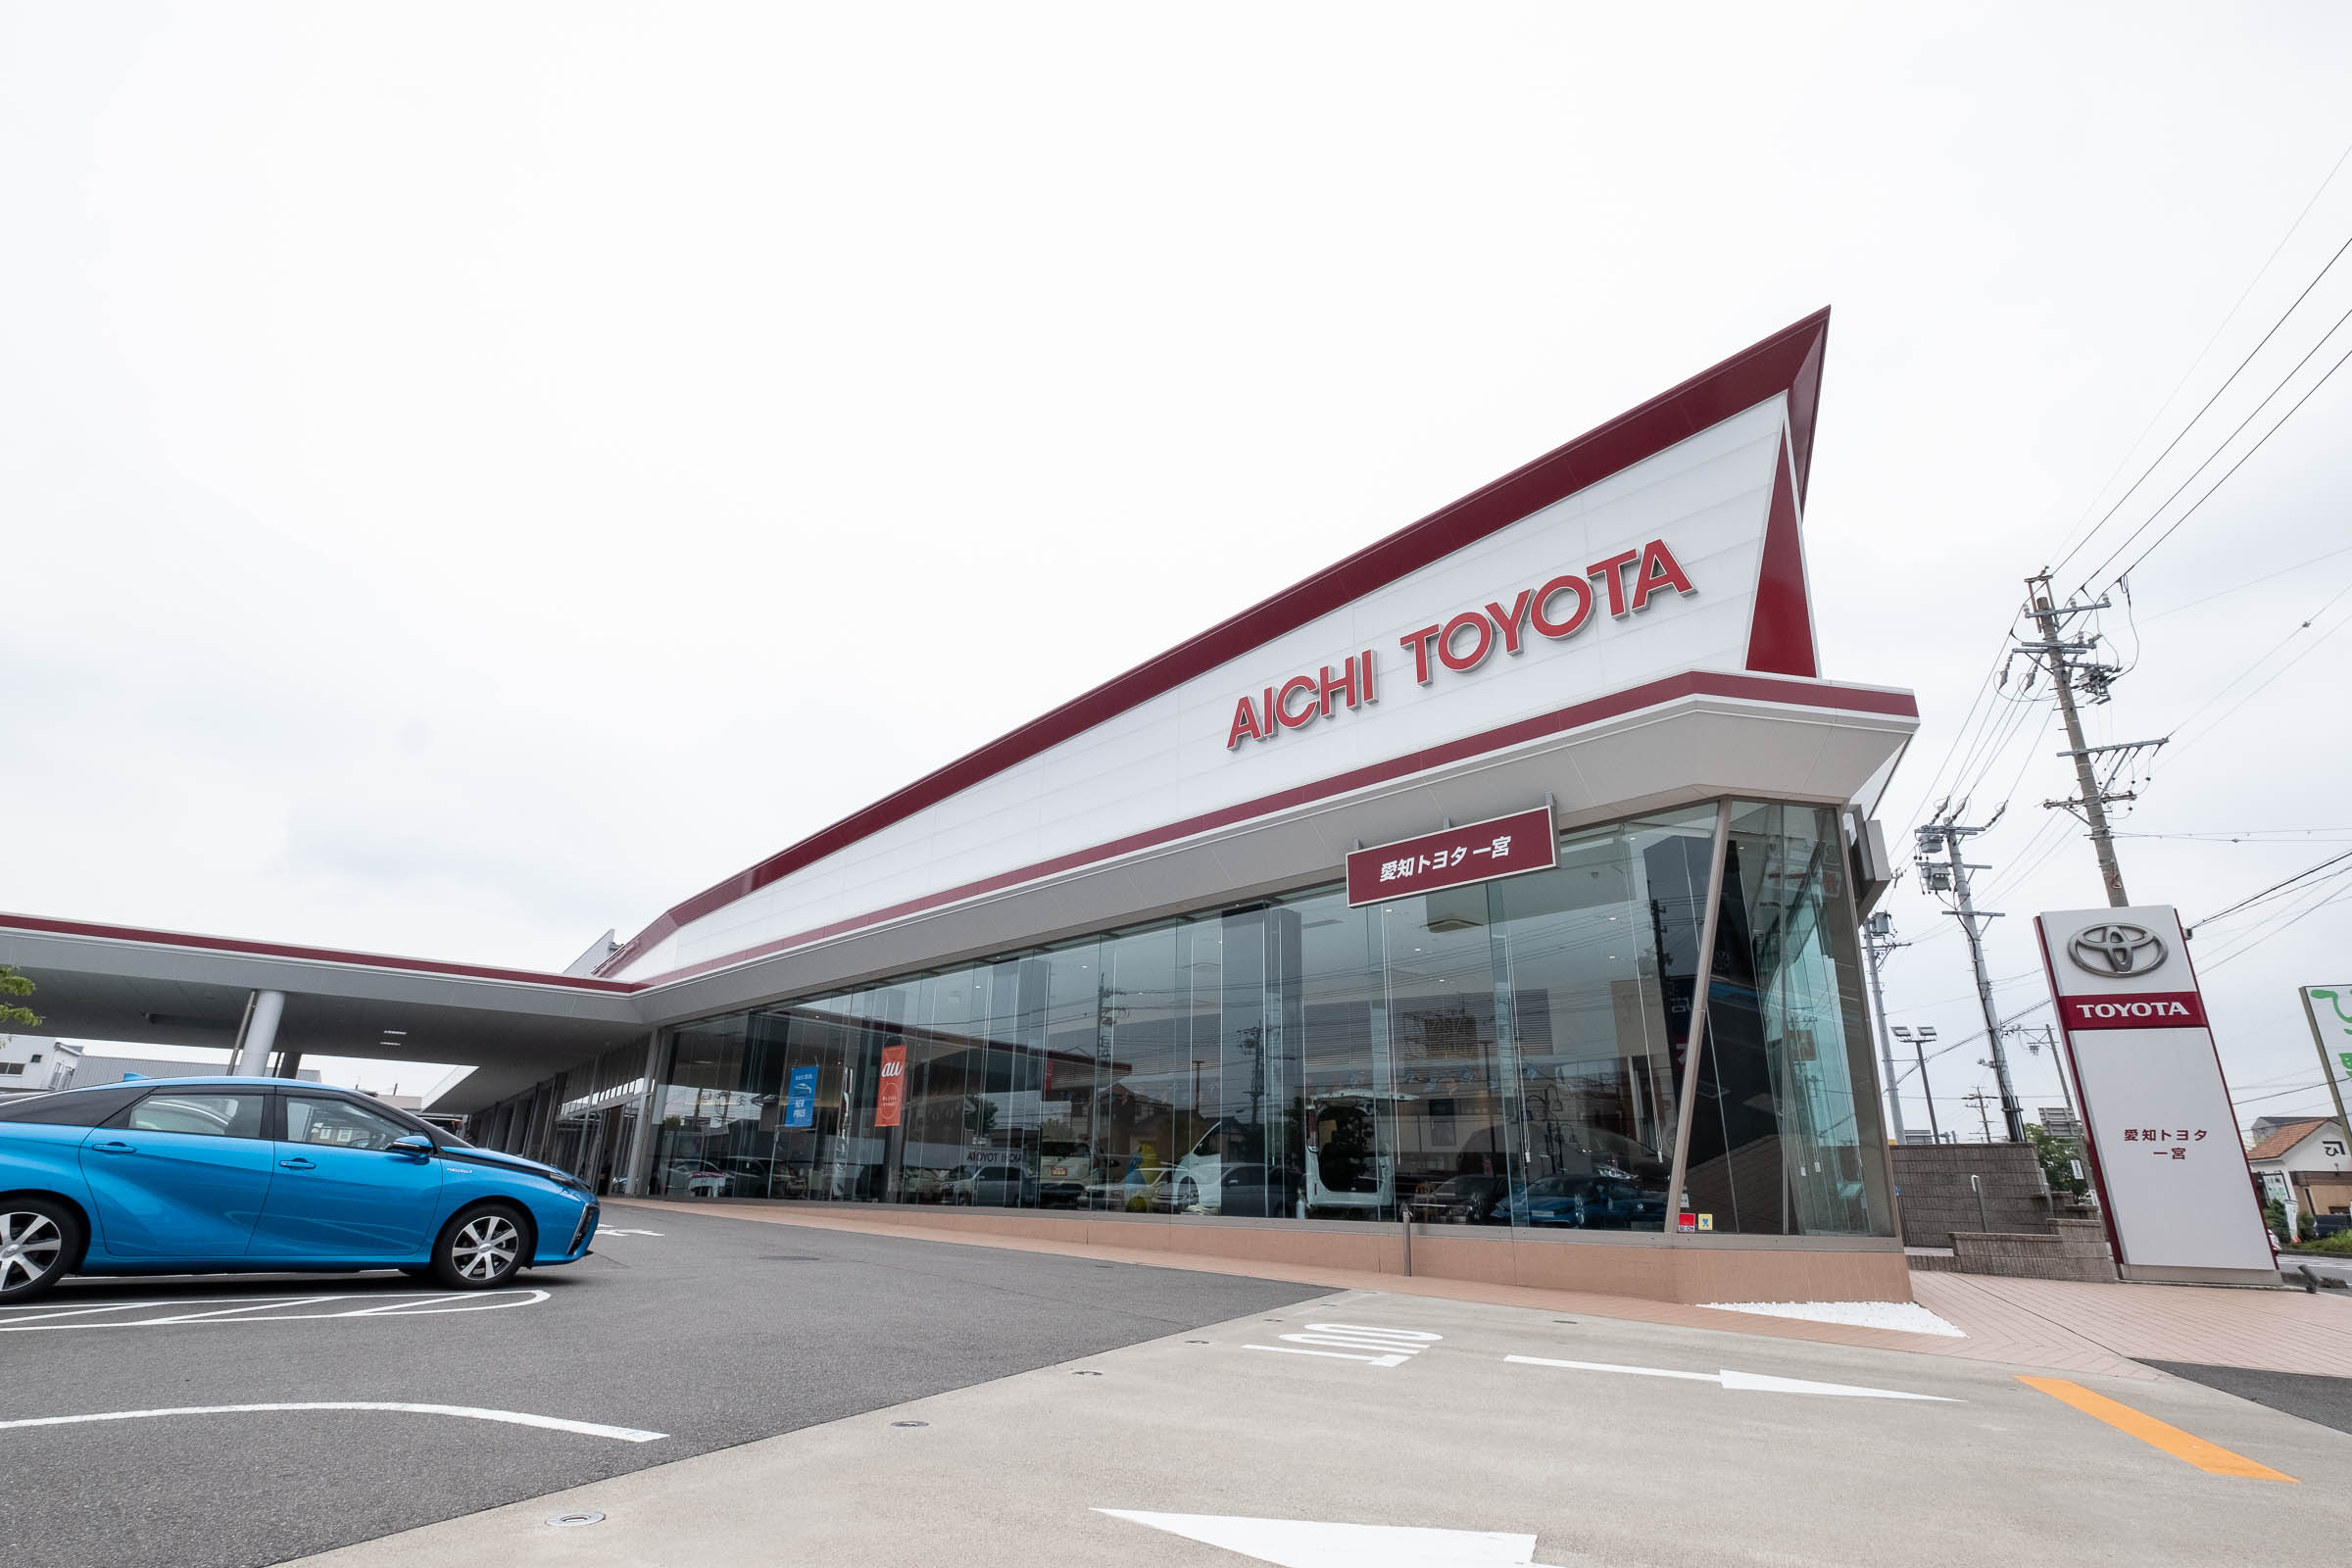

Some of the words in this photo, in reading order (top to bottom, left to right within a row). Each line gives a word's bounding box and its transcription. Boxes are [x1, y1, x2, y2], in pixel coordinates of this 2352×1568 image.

[1226, 650, 1378, 751] AICHI
[1400, 538, 1696, 685] TOYOTA
[1380, 836, 1512, 882] 愛知トヨタ一宮
[2076, 1002, 2190, 1018] TOYOTA
[881, 1061, 902, 1077] au
[2124, 1129, 2208, 1142] 愛知トヨタ
[2153, 1148, 2186, 1160] 一宮
[1240, 1323, 1444, 1368] OUT
